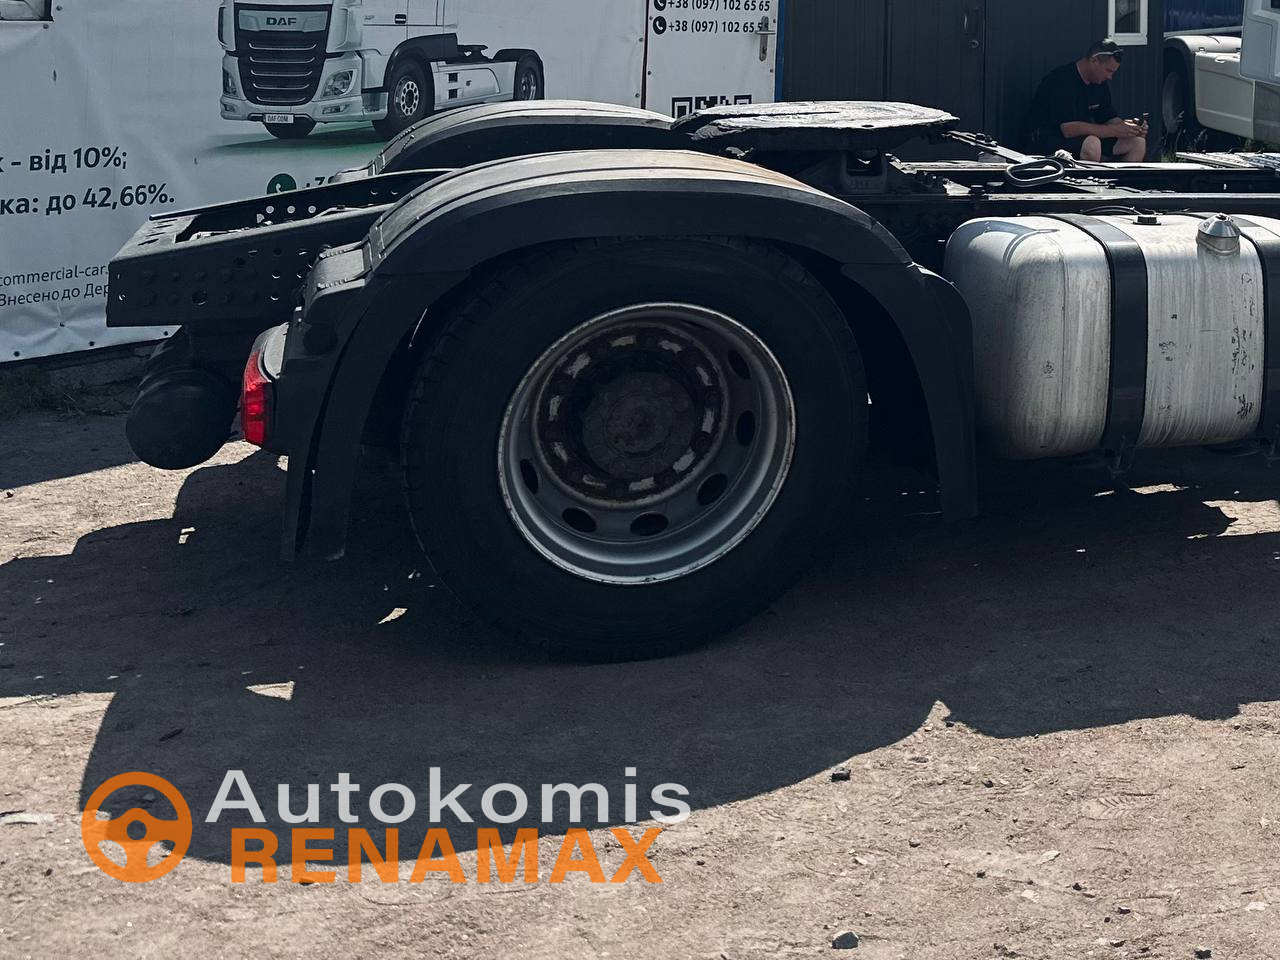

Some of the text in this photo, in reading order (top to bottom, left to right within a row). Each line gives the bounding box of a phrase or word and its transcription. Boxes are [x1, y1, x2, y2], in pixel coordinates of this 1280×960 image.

[723, 0, 741, 10] 102
[743, 0, 757, 11] 65
[758, 0, 770, 11] 65
[265, 17, 297, 26] DAF
[668, 20, 688, 32] +38
[691, 19, 718, 34] (097)
[722, 21, 740, 32] 102
[742, 22, 755, 33] 65
[29, 149, 67, 174] від
[73, 146, 127, 170] 10%;
[0, 183, 175, 216] ка: до 42,66%.
[61, 287, 81, 301] до
